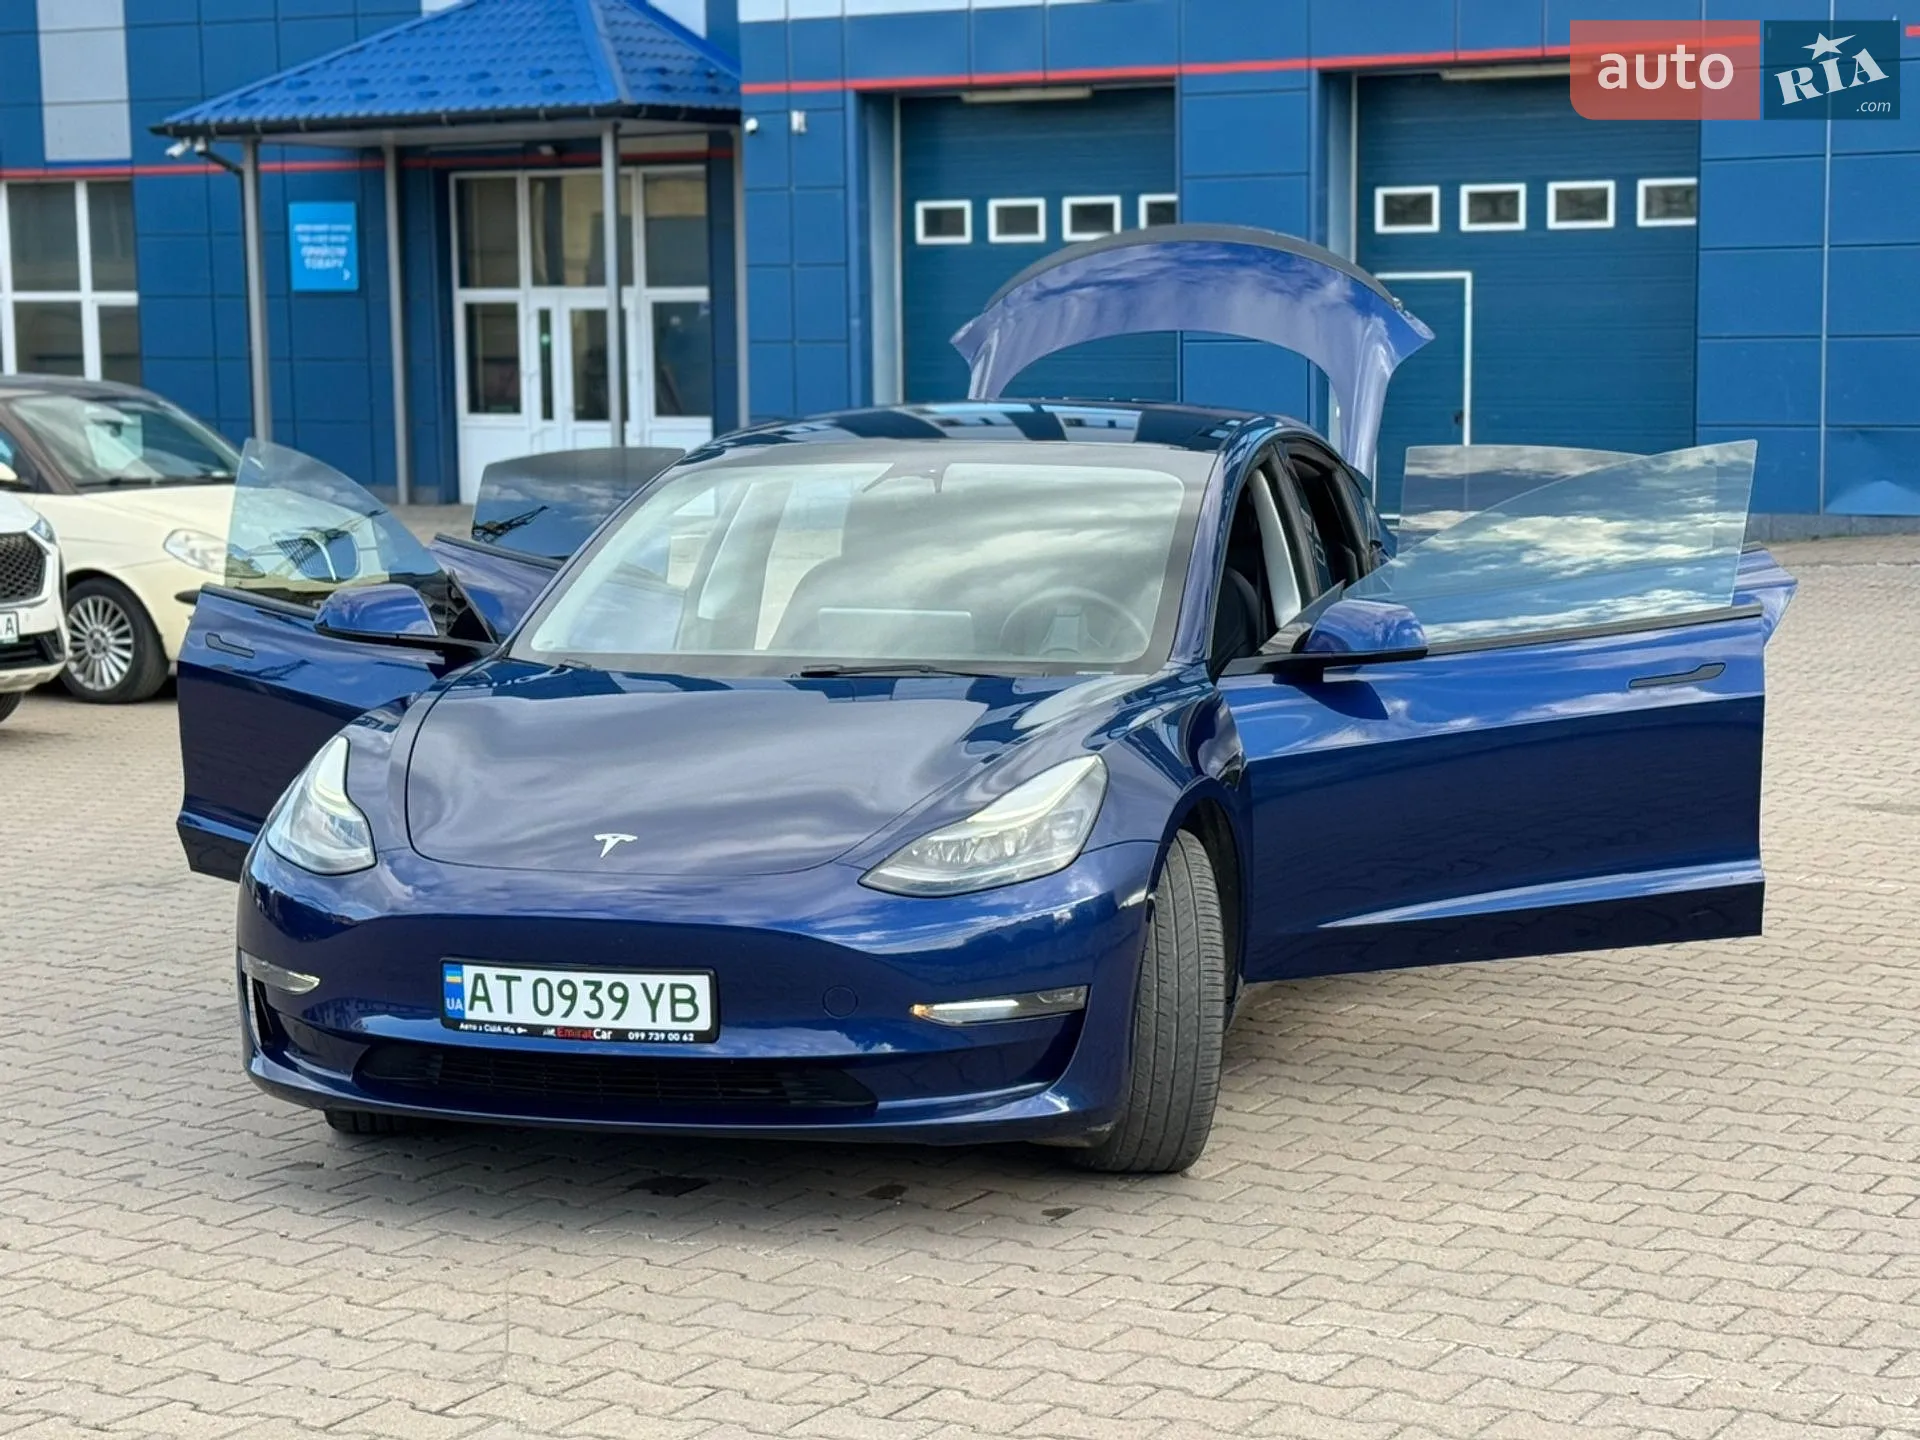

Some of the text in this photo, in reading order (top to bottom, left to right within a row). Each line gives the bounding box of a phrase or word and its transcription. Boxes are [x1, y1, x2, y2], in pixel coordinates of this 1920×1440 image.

[468, 972, 700, 1023] AT 0939 YB
[446, 998, 464, 1010] UA
[667, 1032, 680, 1041] 00
